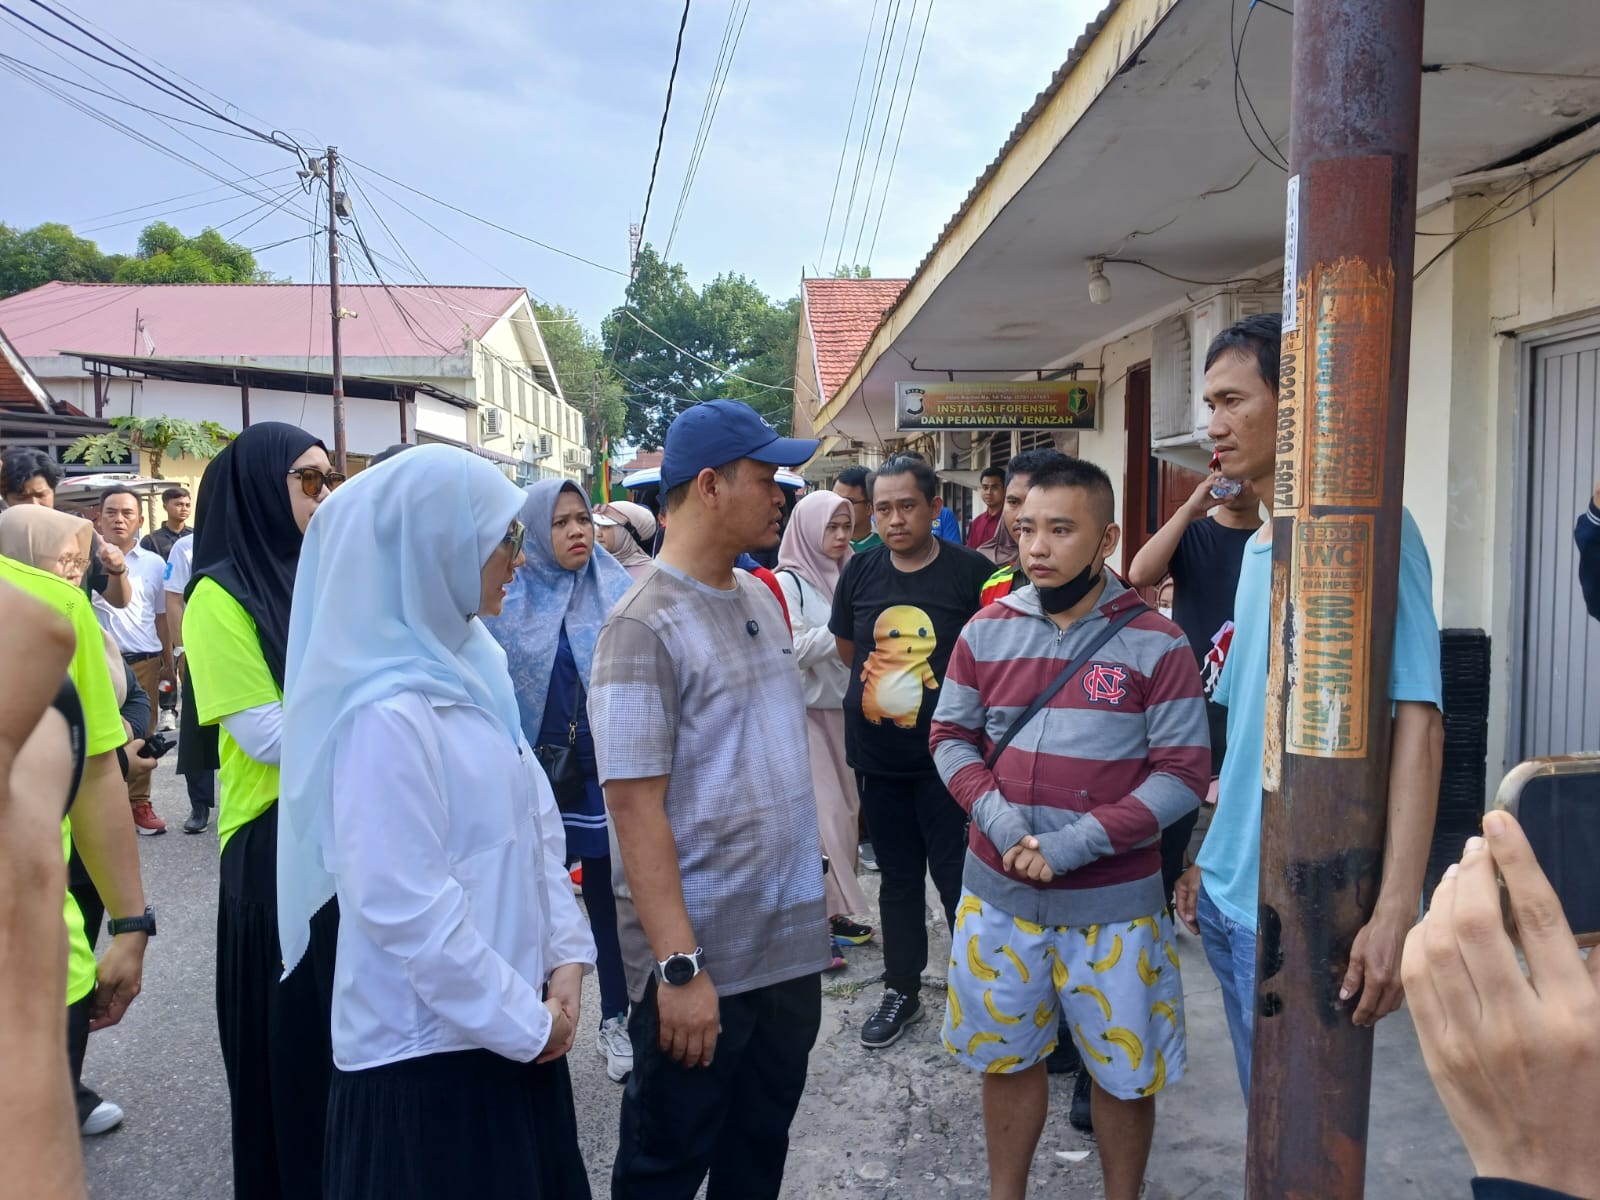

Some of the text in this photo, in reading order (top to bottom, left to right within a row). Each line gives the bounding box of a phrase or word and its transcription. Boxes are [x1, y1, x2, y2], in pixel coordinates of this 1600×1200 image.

[937, 404, 1057, 413] INSTALASI FORENSIK
[921, 416, 1073, 424] DAN PERAWATAN JENAZAH
[1303, 527, 1361, 540] SEDOT
[1304, 545, 1358, 568] WC
[1305, 595, 1355, 642] 0813
